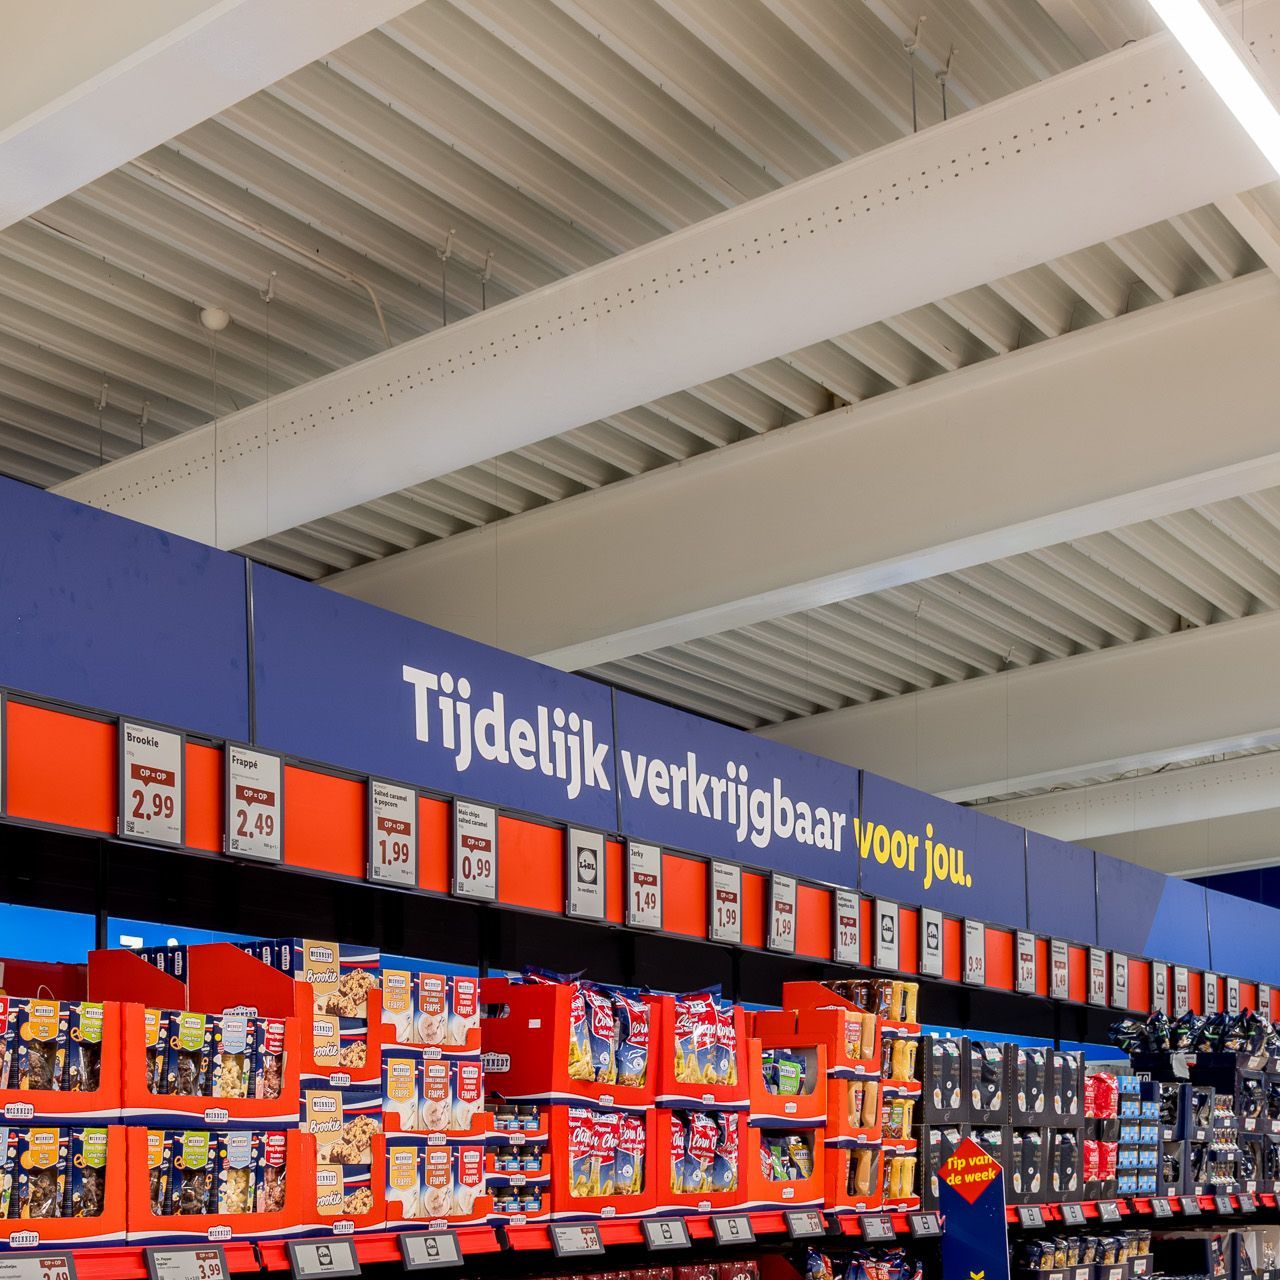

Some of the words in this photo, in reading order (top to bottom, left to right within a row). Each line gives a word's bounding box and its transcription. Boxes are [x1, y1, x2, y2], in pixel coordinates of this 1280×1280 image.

[127, 732, 159, 748] Brookie
[232, 754, 258, 769] Frappé
[140, 769, 150, 777] OP
[156, 772, 167, 781] OP
[402, 665, 611, 800] Tijdelijk
[621, 751, 846, 849] verkrijgbaar
[854, 816, 919, 873] voor
[924, 822, 972, 889] jou.
[244, 789, 253, 797] OP
[258, 792, 268, 800] OP
[374, 789, 389, 799] Salted
[390, 792, 408, 802] caramel
[132, 789, 174, 821] 2.99
[379, 798, 398, 808] popcorn
[469, 811, 480, 819] chips
[237, 809, 274, 838] 2.49
[397, 823, 405, 831] OP
[472, 820, 488, 828] caramel
[379, 839, 409, 866] 1.99
[631, 849, 643, 859] Jerky
[462, 856, 491, 880] 0.99
[635, 891, 656, 912] 1.49
[718, 908, 736, 928] 1.99
[775, 917, 791, 937] 1.99
[840, 931, 857, 947] 12.99
[968, 956, 983, 973] 9.99
[306, 968, 338, 983] Brookie
[1021, 966, 1033, 981] 1.99
[424, 1003, 440, 1013] FRAPPÉ
[458, 1004, 473, 1015] FRAPPÉ
[310, 1118, 341, 1133] Brookie
[946, 1155, 966, 1171] Tip
[969, 1154, 992, 1167] van
[946, 1171, 962, 1185] de
[965, 1167, 996, 1182] week
[198, 1264, 221, 1280] 3.99
